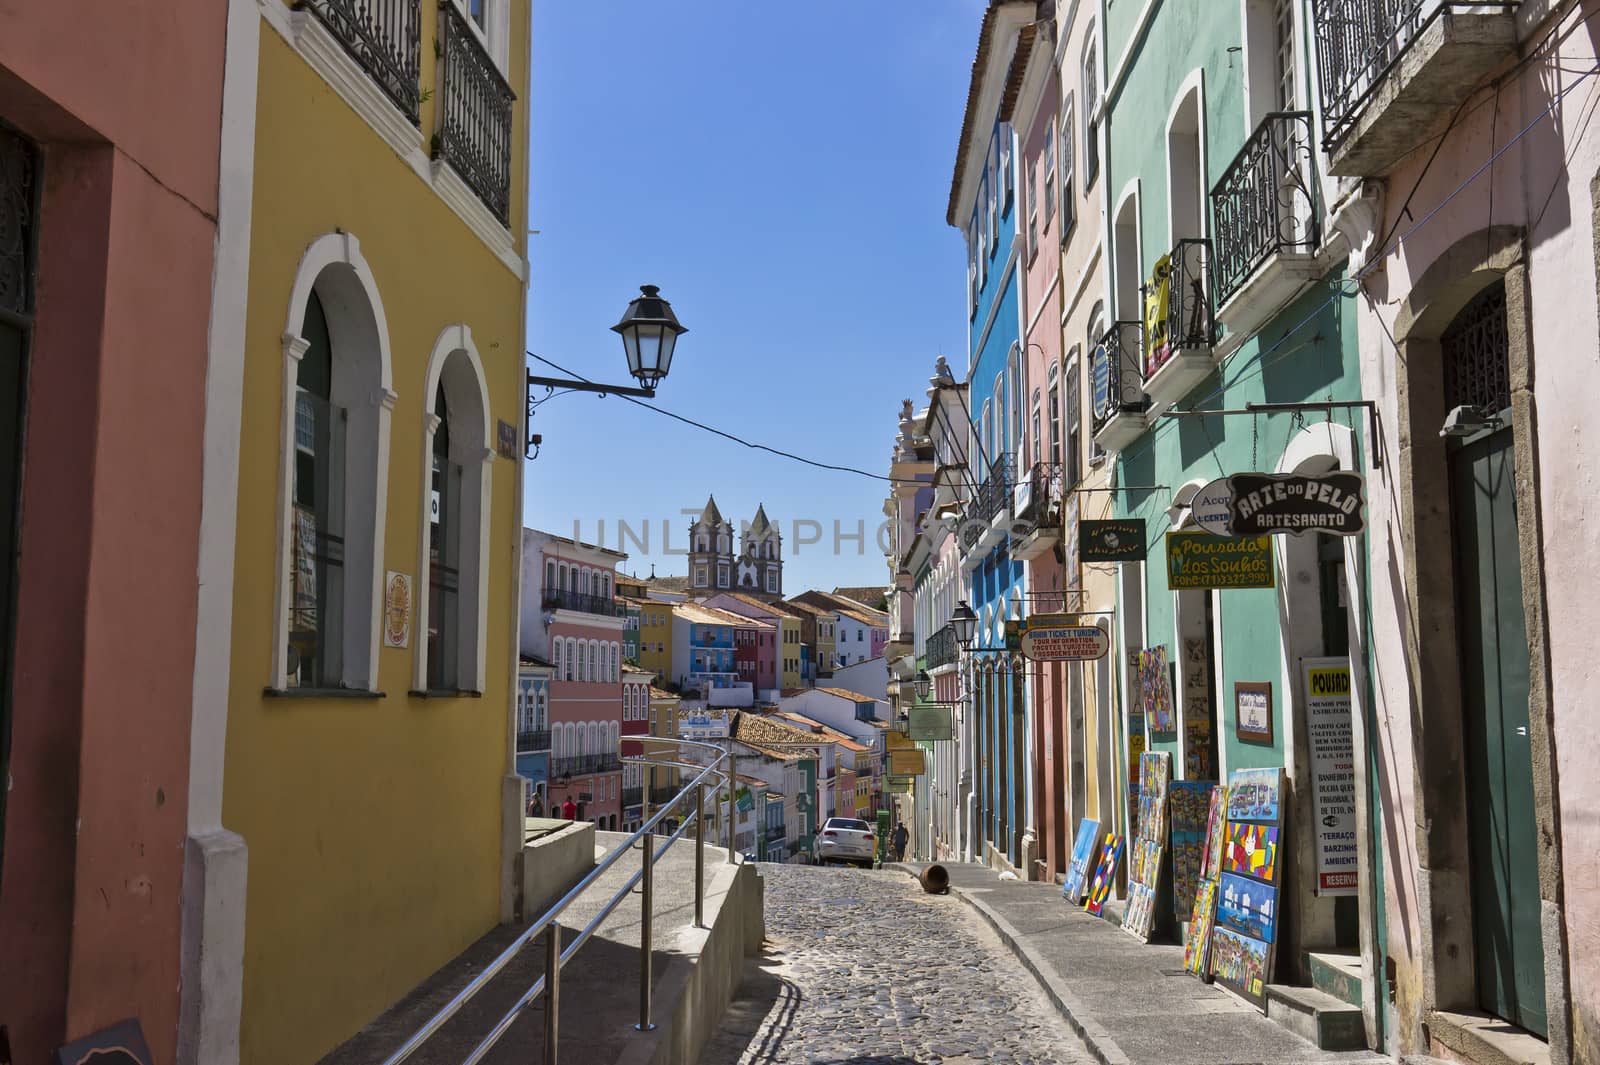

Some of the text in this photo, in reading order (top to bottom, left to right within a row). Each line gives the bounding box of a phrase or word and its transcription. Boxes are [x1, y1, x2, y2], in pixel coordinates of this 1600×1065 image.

[1237, 482, 1287, 519] ARTE
[1287, 484, 1303, 495] DO
[1257, 514, 1345, 527] ARTESANATO
[1182, 537, 1259, 555] Pousada
[1182, 556, 1267, 574] dos Sonhos
